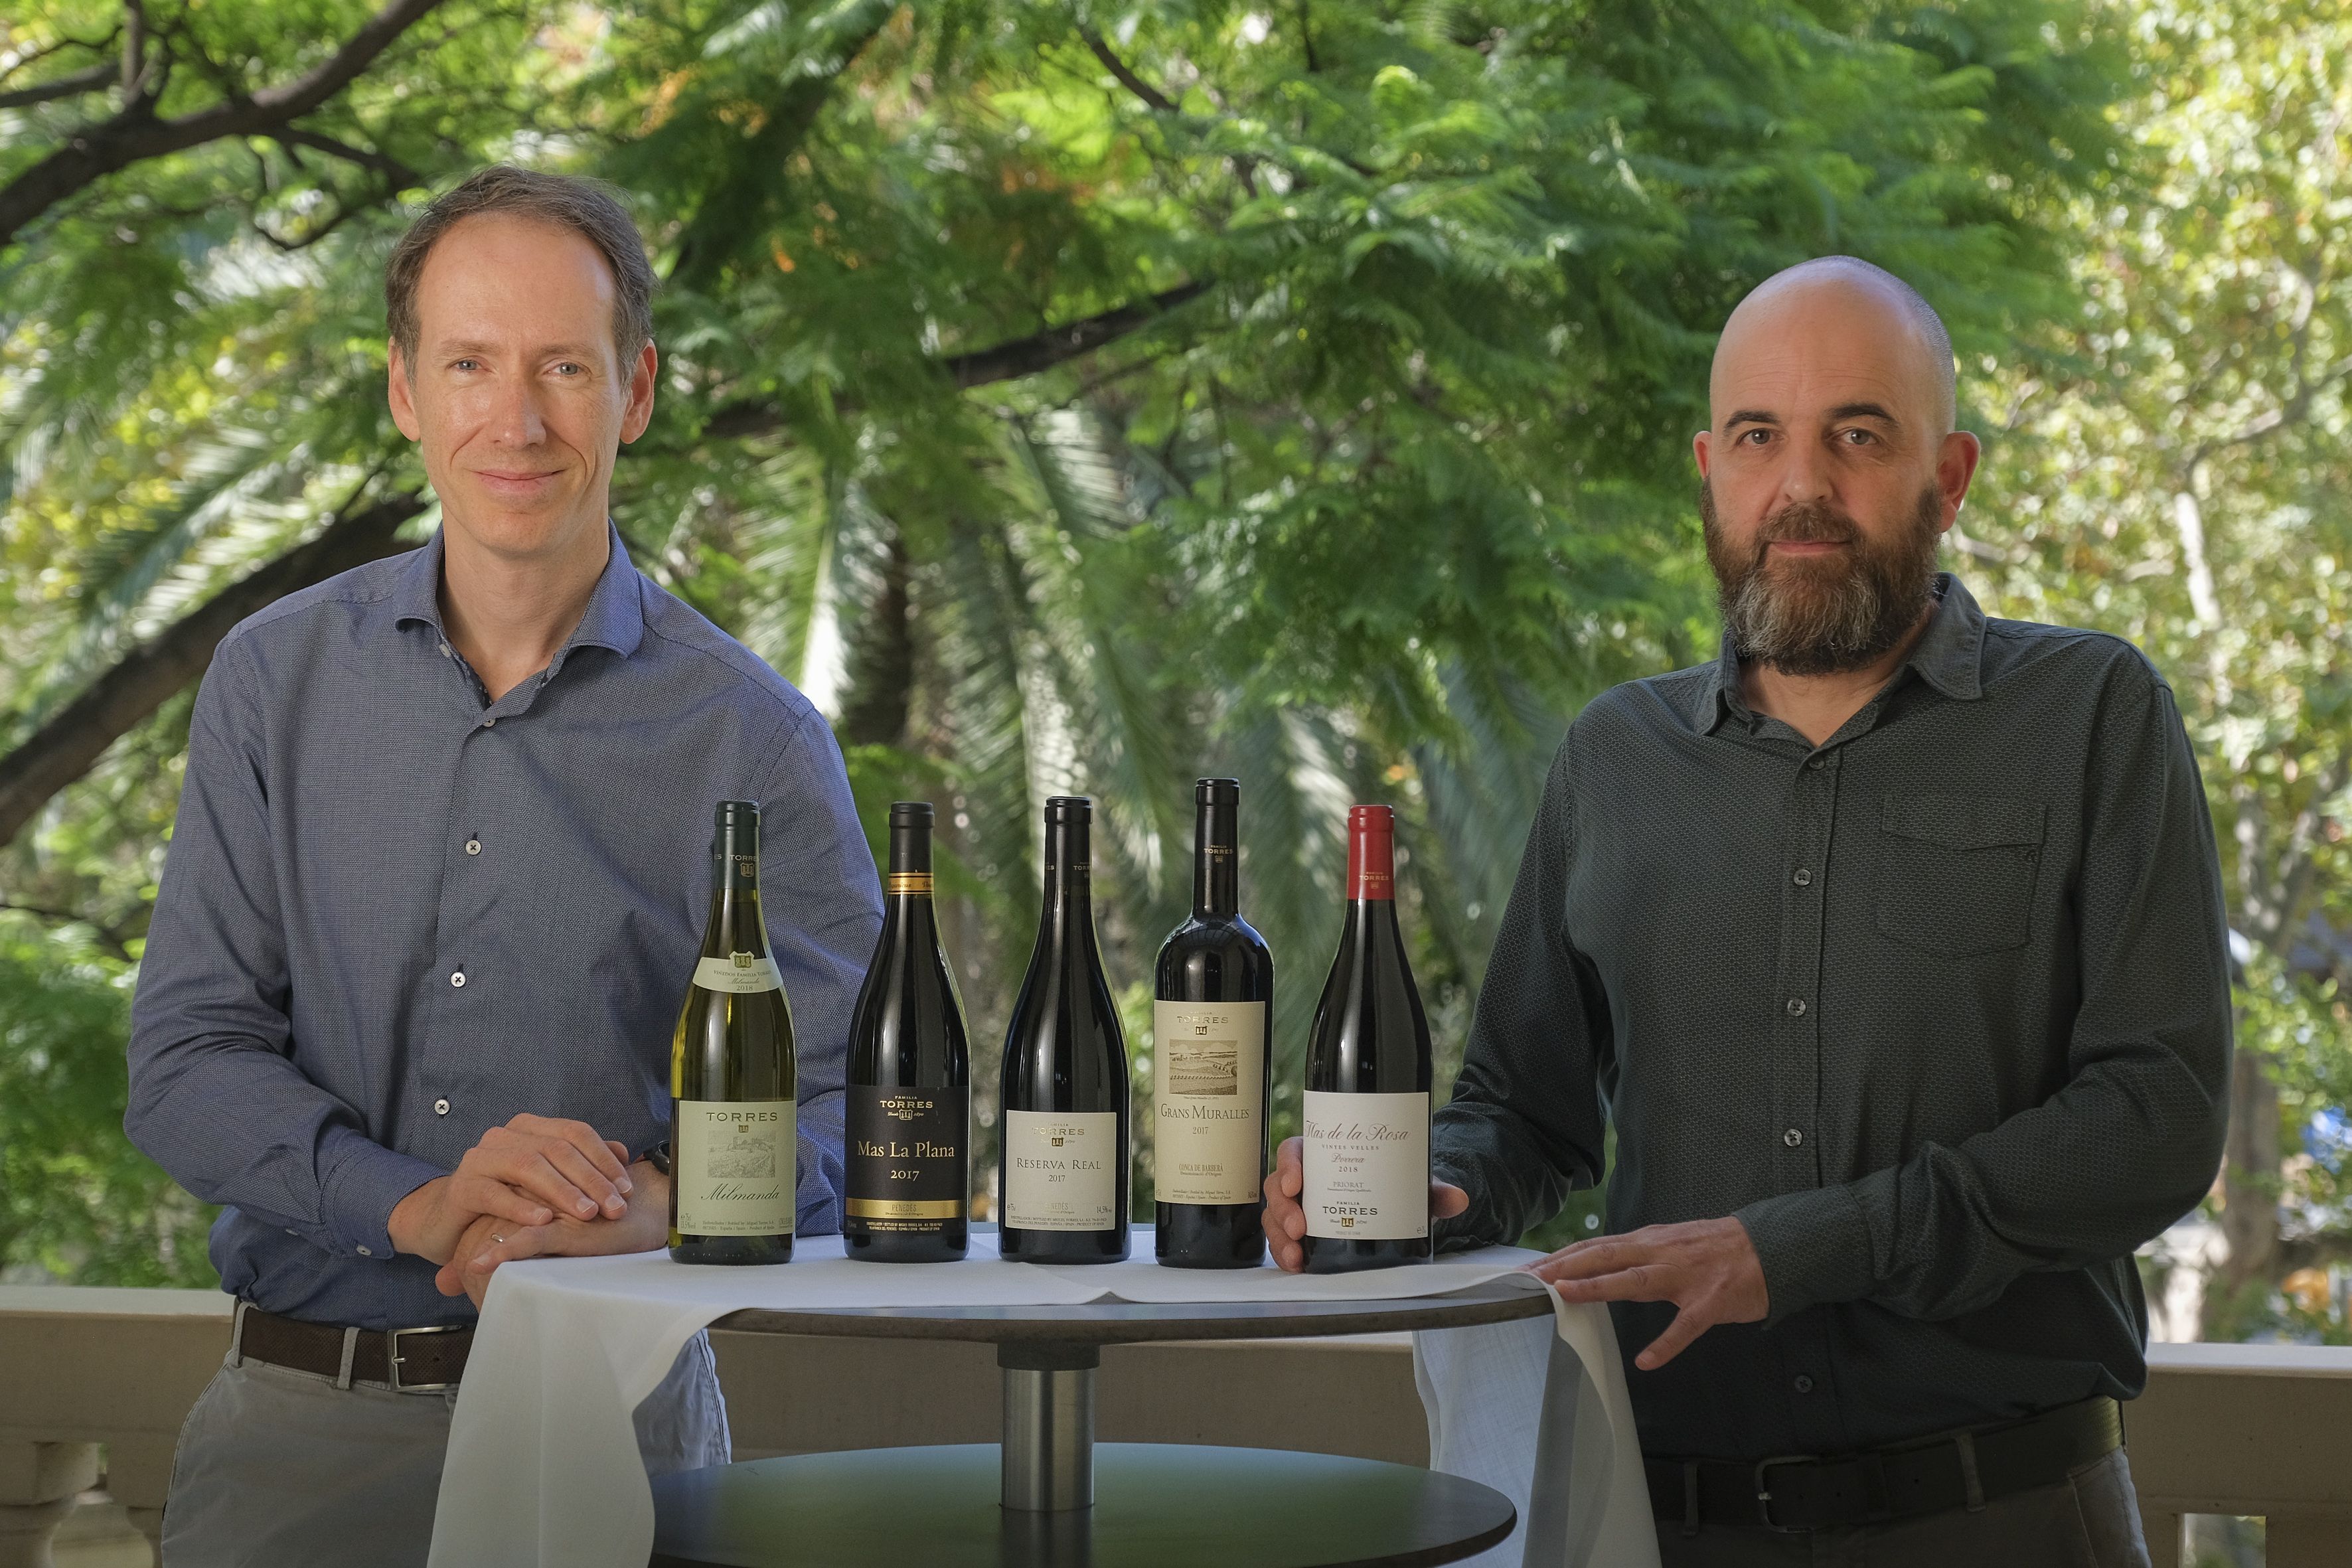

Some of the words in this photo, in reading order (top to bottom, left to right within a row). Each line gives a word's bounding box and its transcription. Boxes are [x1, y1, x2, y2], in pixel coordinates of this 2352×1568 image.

[706, 1112, 778, 1122] TORRES
[1161, 1103, 1190, 1119] GRANS
[1192, 1105, 1249, 1120] MURALLES
[1032, 1127, 1085, 1136] TORRES
[1192, 1127, 1209, 1135] 2017
[1328, 1123, 1344, 1140] de
[1346, 1123, 1364, 1140] la
[1366, 1123, 1411, 1141] Rosa
[858, 1140, 885, 1157] Mas
[889, 1141, 909, 1158] La
[914, 1140, 955, 1158] Plana
[1016, 1157, 1066, 1170] RESERVA
[1072, 1159, 1102, 1170] REAL
[890, 1170, 920, 1182] 2017
[700, 1182, 781, 1201] Milmanda
[1322, 1206, 1378, 1215] TORRES
